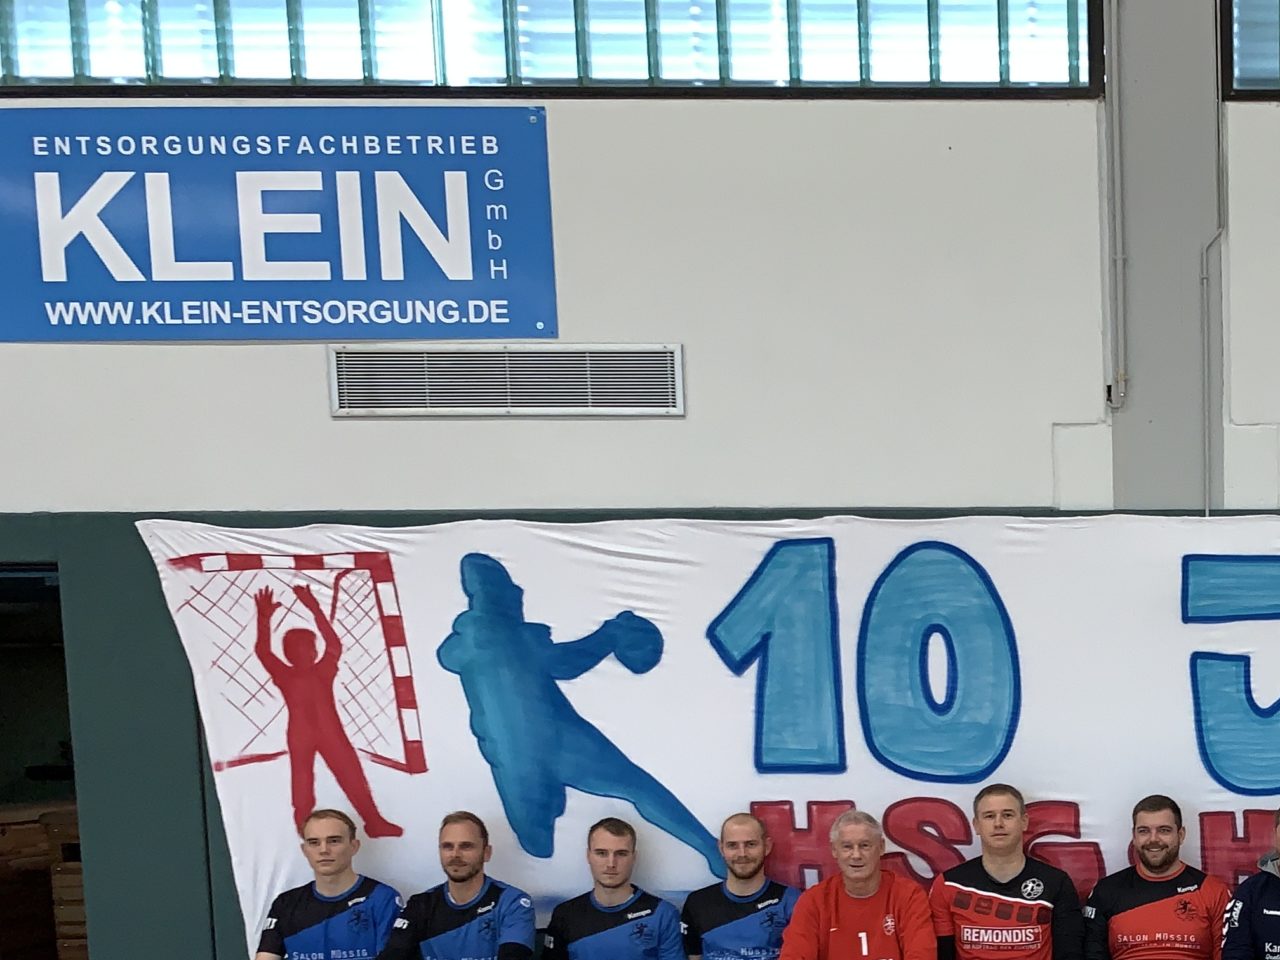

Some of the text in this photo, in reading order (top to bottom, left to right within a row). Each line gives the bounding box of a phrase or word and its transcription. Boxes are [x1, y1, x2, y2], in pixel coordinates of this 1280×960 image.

[33, 135, 501, 156] ENTSORGUNGSFACHBETRIEB
[34, 171, 474, 282] KLEIN
[484, 169, 508, 280] GmbH
[45, 300, 511, 325] WWW.KLEIN-ENTSORGUNG.DE
[705, 536, 1022, 785] 10
[857, 931, 869, 956] 1
[963, 927, 1035, 943] REMONDIS
[1117, 934, 1149, 943] SALON
